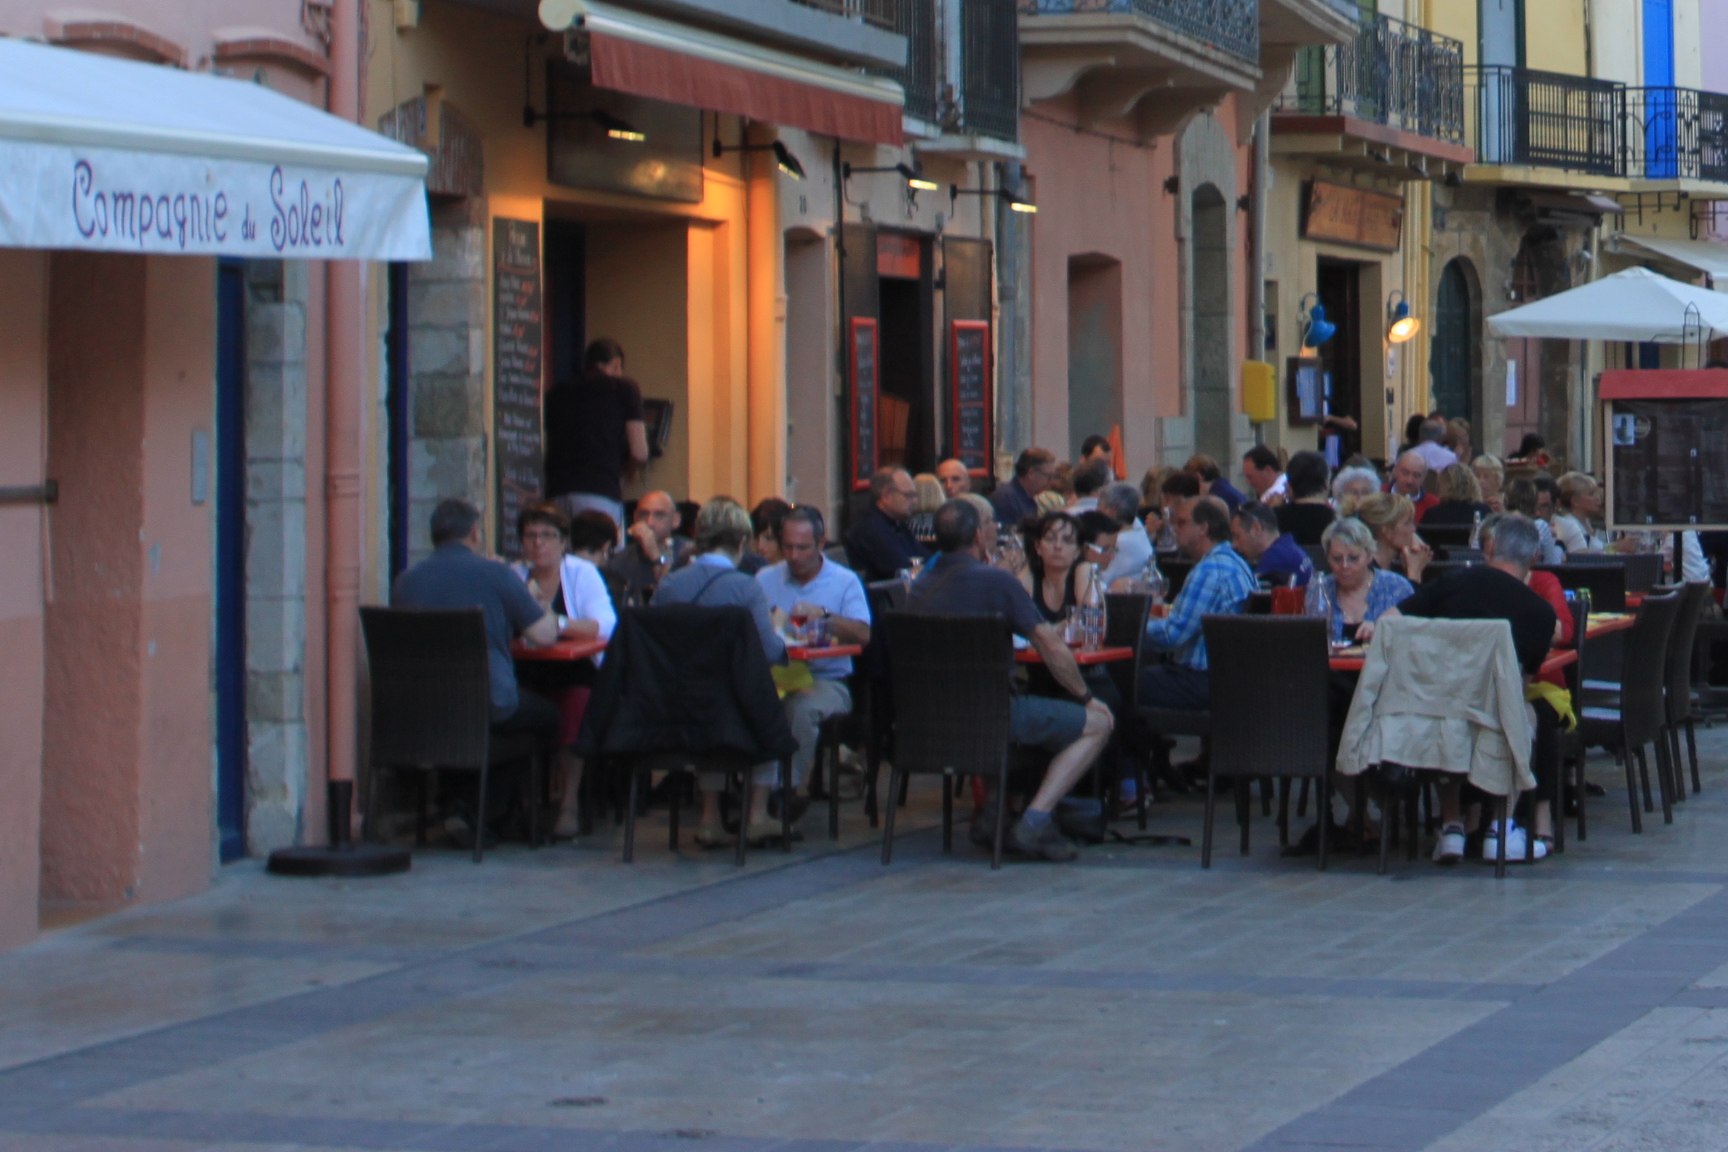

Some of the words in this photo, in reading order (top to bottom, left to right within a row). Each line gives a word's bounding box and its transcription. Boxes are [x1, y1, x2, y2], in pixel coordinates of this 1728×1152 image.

[72, 160, 228, 250] Compagnie
[241, 203, 257, 241] du
[270, 164, 344, 252] Soleil
